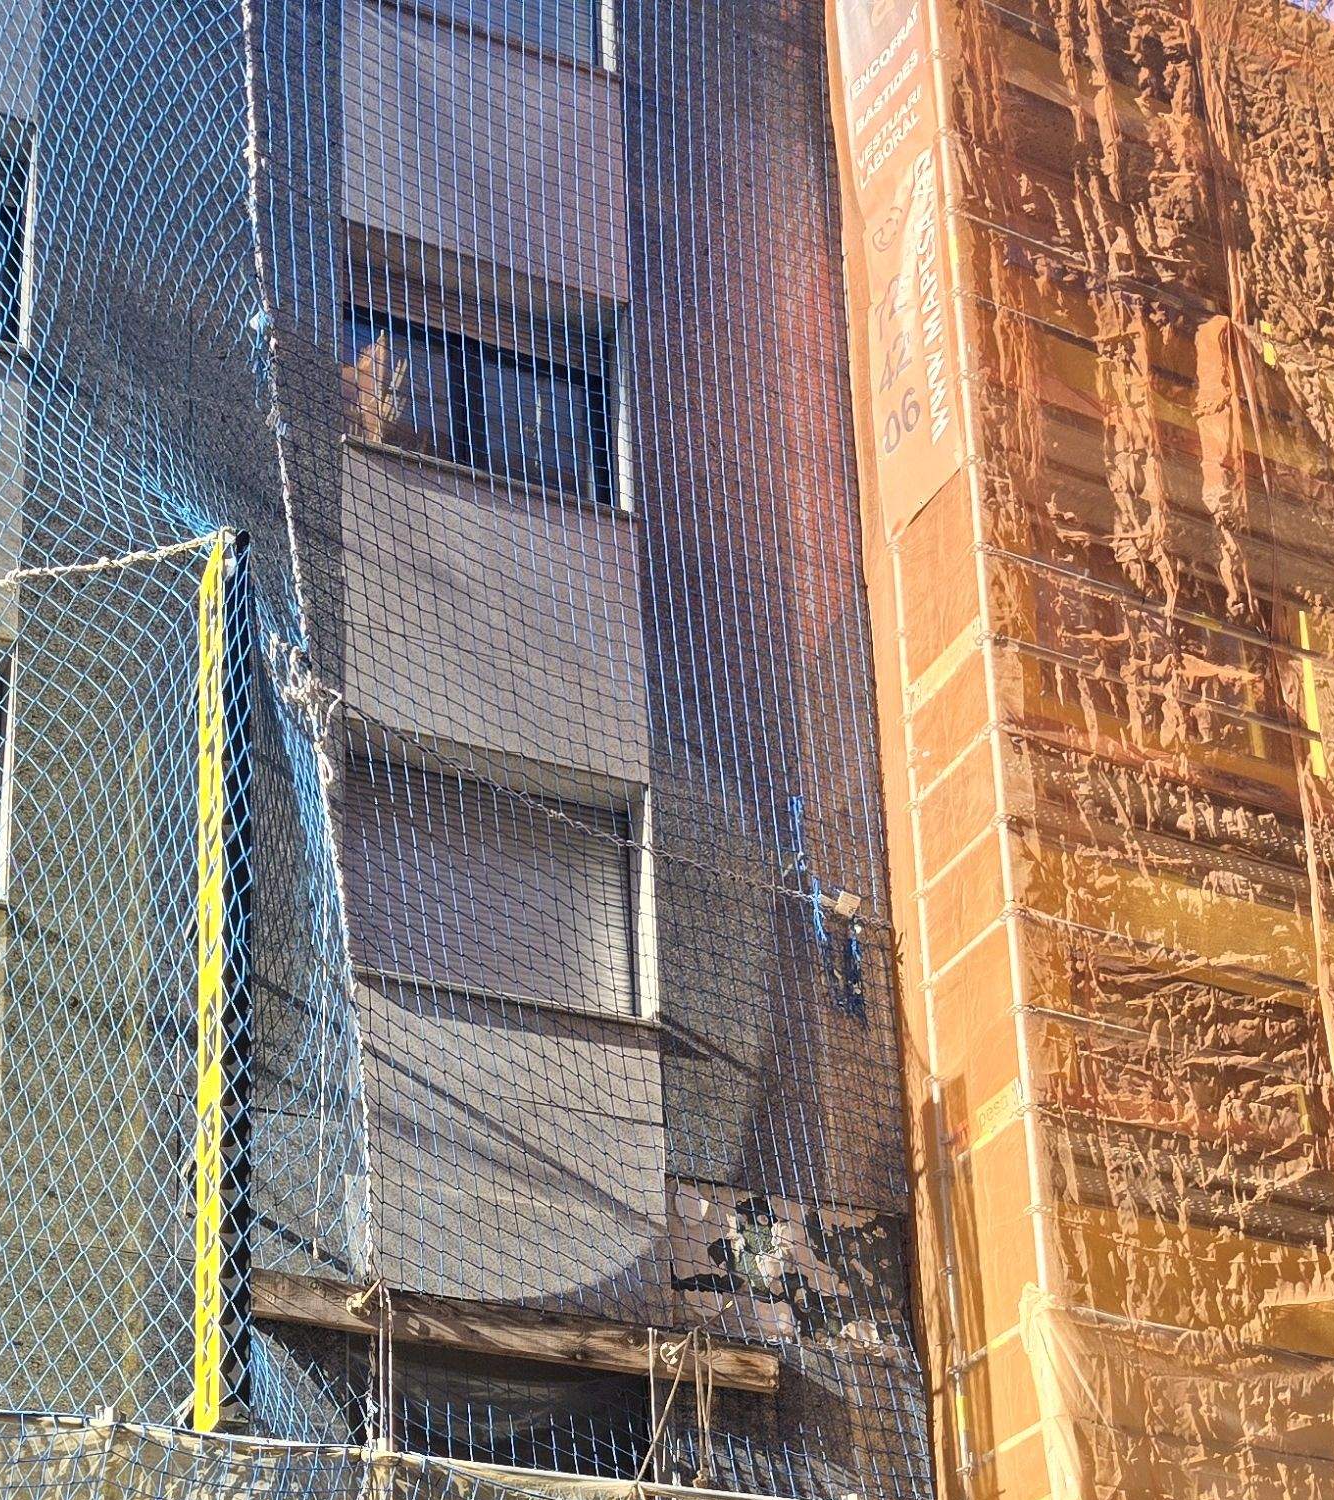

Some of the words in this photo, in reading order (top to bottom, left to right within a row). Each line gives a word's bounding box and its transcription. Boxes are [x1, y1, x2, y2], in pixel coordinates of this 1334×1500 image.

[855, 48, 919, 136] BASTIDES
[857, 85, 923, 168] VESTUARI
[860, 112, 921, 190] LABORAL
[878, 332, 913, 395] 42
[883, 387, 920, 453] 06
